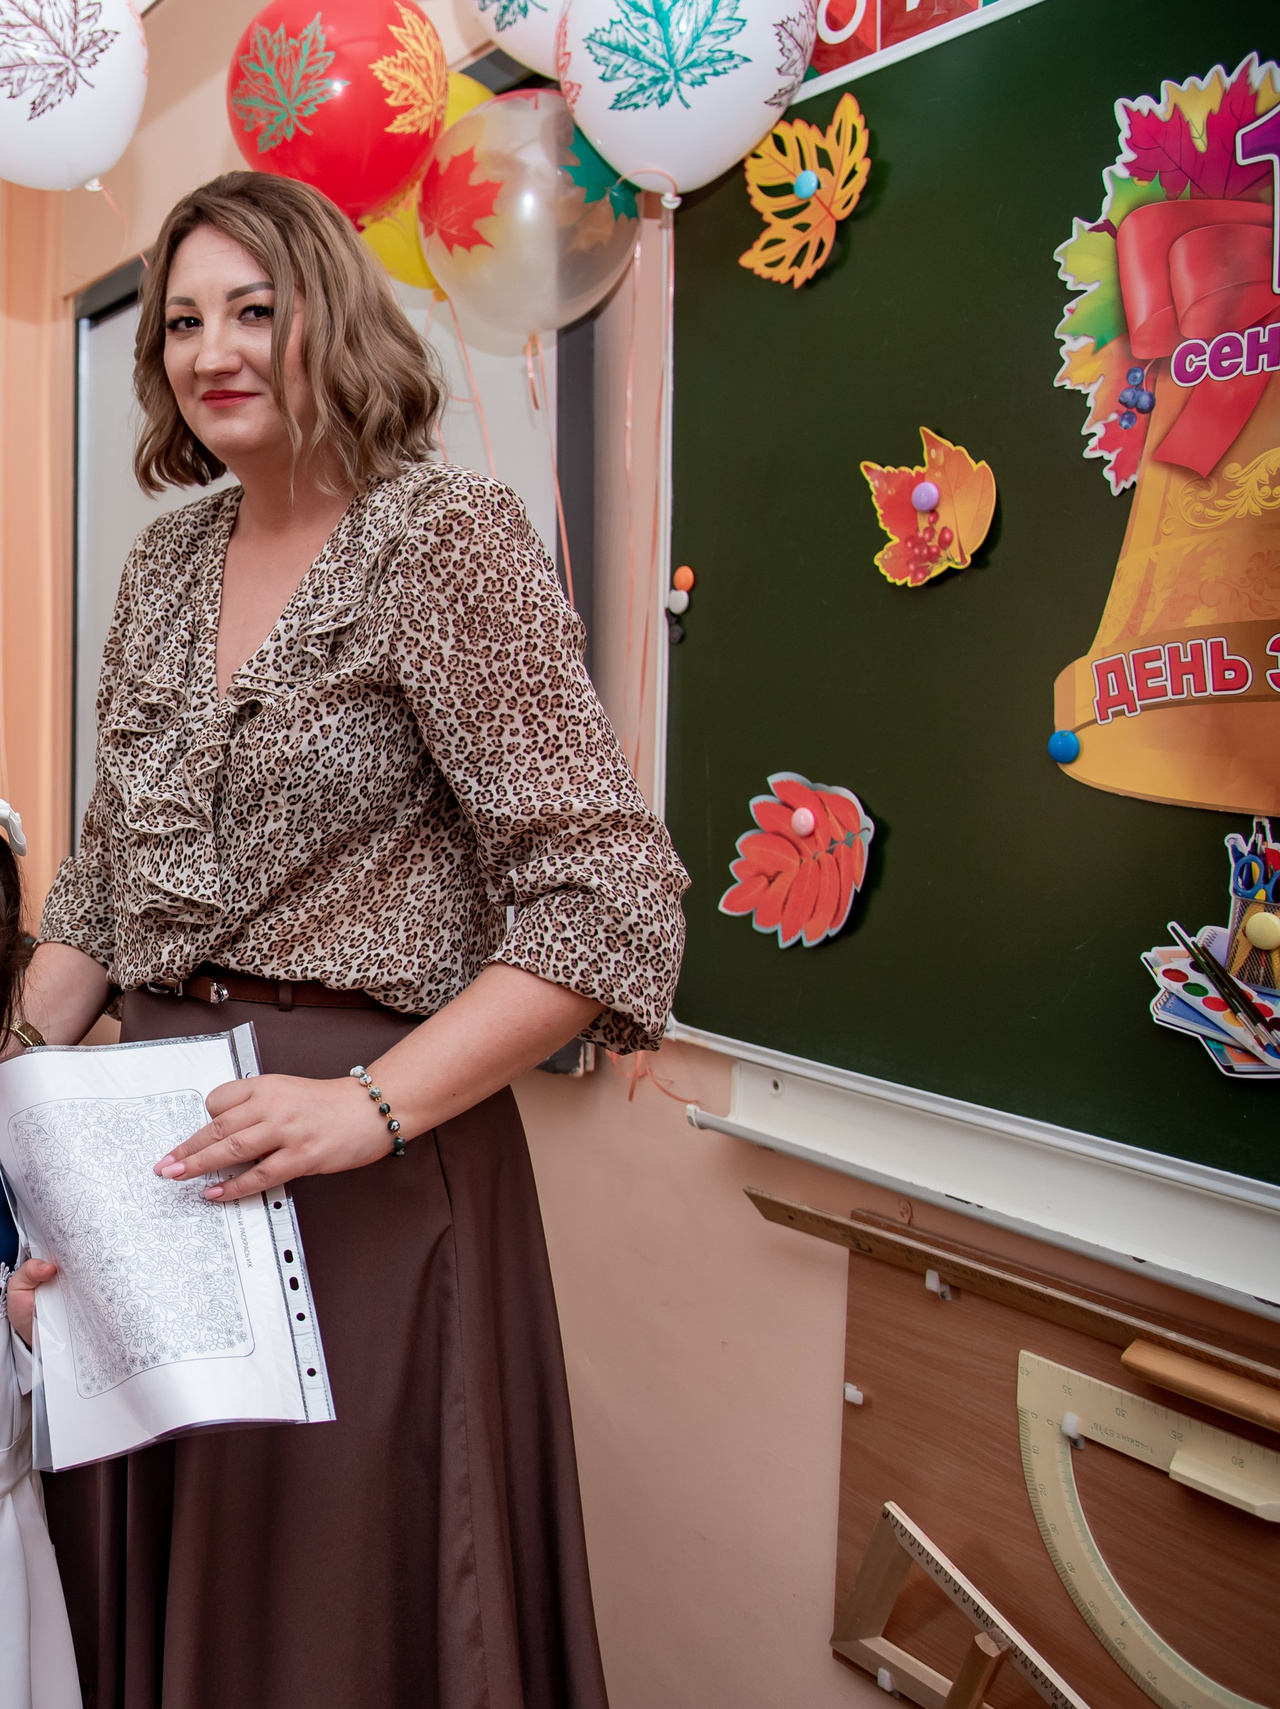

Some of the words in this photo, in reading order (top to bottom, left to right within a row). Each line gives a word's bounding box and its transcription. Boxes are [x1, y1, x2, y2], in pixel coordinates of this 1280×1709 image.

[1092, 637, 1253, 725] ДЕНЬ
[240, 1227, 251, 1257] РАСКРАСЬ
[246, 1258, 253, 1268] ИХ
[1062, 1385, 1073, 1397] 35
[1115, 1408, 1126, 1419] 30
[1170, 1430, 1183, 1442] 25
[1032, 1445, 1039, 1455] 10
[1231, 1456, 1244, 1468] 20
[1038, 1484, 1047, 1497] 20
[1049, 1523, 1058, 1535] 30
[1066, 1562, 1076, 1574] 40
[1088, 1601, 1100, 1614] 50
[1146, 1671, 1158, 1685] 70
